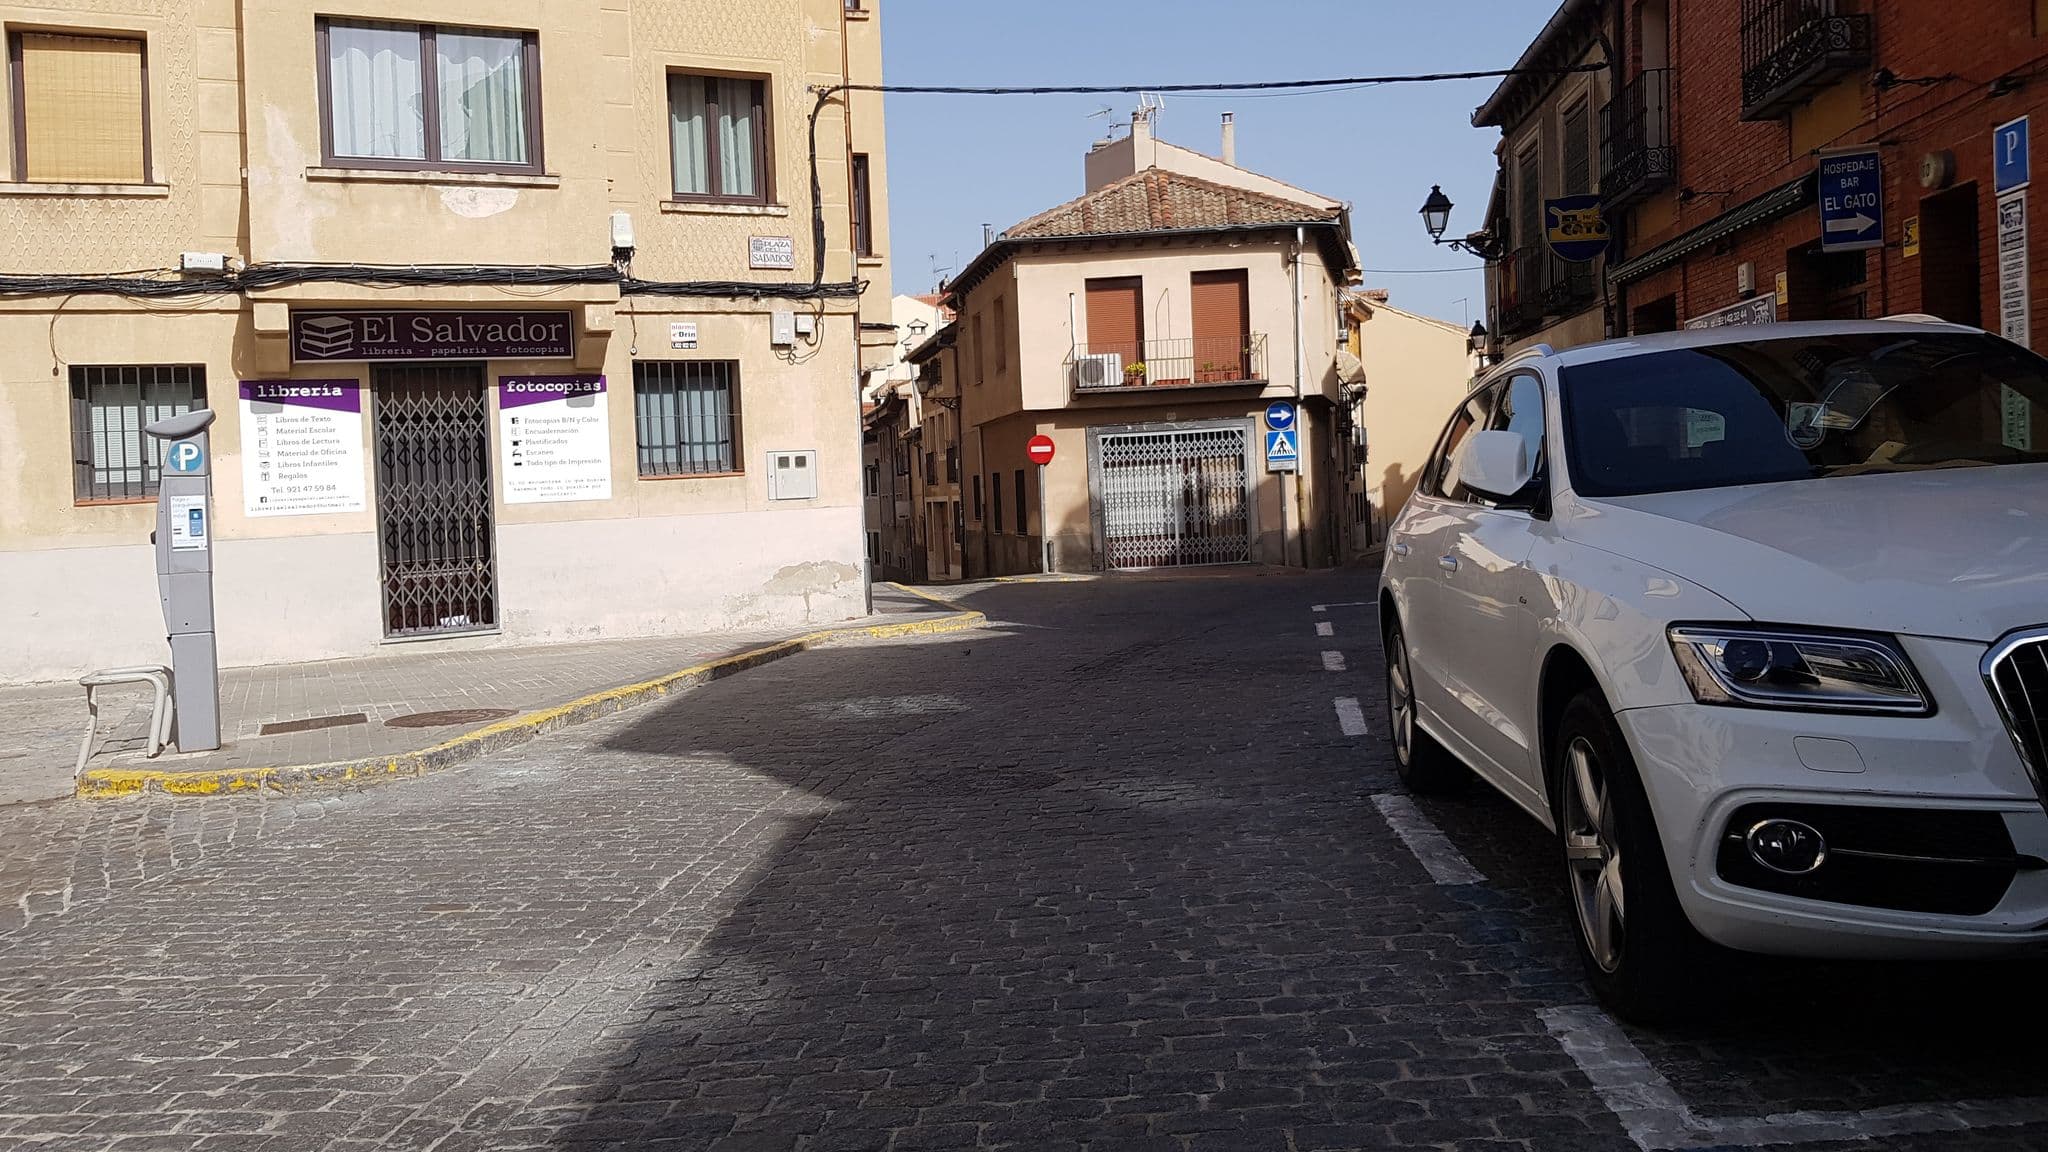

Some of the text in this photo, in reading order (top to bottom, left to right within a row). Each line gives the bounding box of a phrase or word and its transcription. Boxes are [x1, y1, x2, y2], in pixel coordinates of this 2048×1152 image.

[2004, 131, 2017, 166] P
[1824, 159, 1875, 175] HOSPEDAJE
[1840, 176, 1860, 189] BAR
[1824, 192, 1876, 212] EL GATO
[753, 254, 792, 264] SALVADOR
[360, 316, 563, 344] El Salvador
[505, 345, 565, 355] fotocopias
[257, 384, 343, 398] librería
[506, 380, 602, 394] fotocopias
[179, 443, 199, 471] P
[278, 472, 308, 481] Regalos
[286, 485, 300, 493] 921
[314, 484, 325, 492] 59
[326, 484, 336, 492] 84
